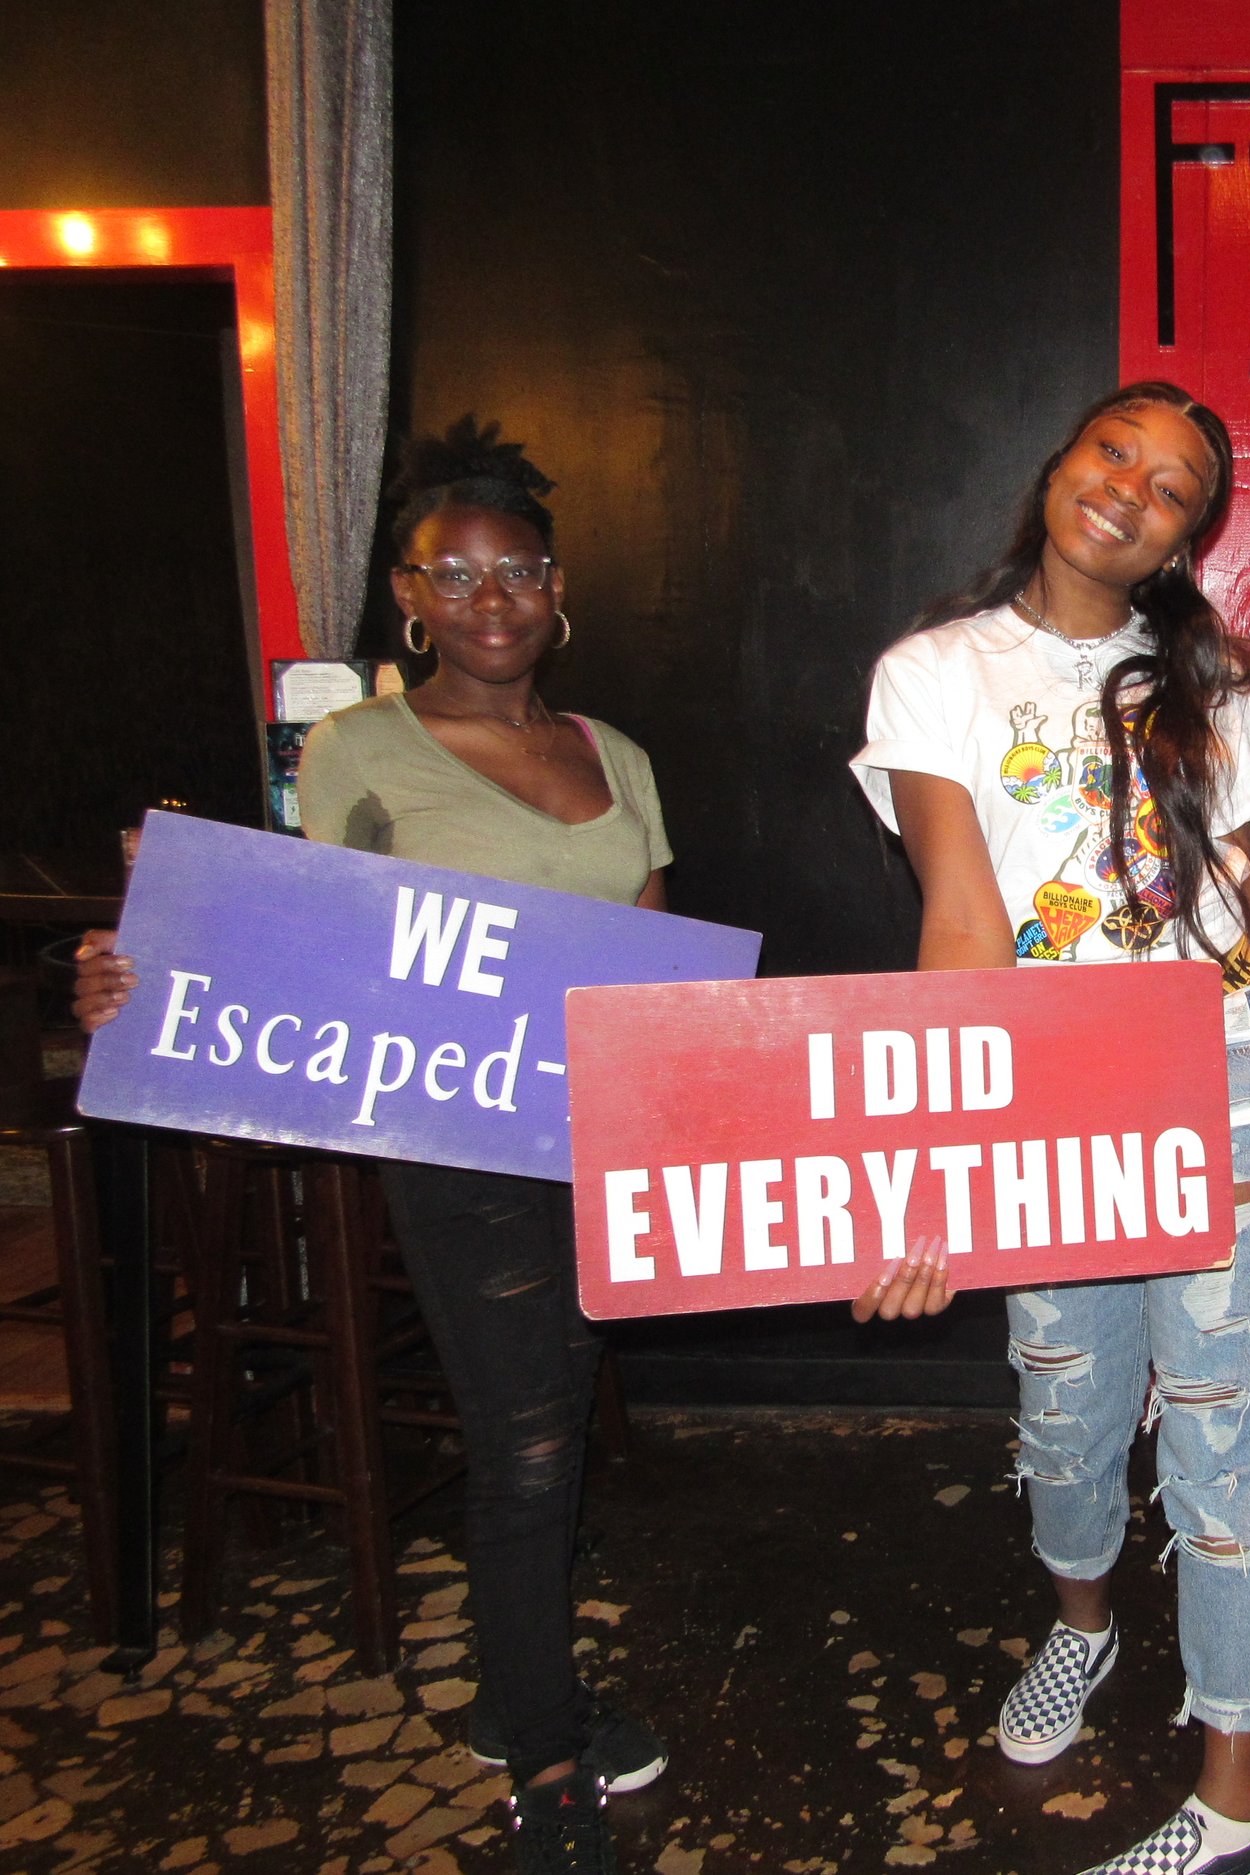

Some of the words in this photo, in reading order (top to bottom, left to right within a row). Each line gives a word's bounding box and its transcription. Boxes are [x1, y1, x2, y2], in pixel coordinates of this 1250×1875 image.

[1042, 891, 1094, 908] BILLIONAIRE
[1048, 900, 1068, 909] BOYS
[1069, 903, 1087, 913] CLUB
[389, 885, 518, 998] WE
[1030, 941, 1046, 958] ON
[1033, 930, 1048, 944] GRO
[150, 969, 566, 1127] Escaped-
[808, 1033, 835, 1120] I
[862, 1025, 1014, 1117] DID
[604, 1127, 1210, 1284] EVERYTHING
